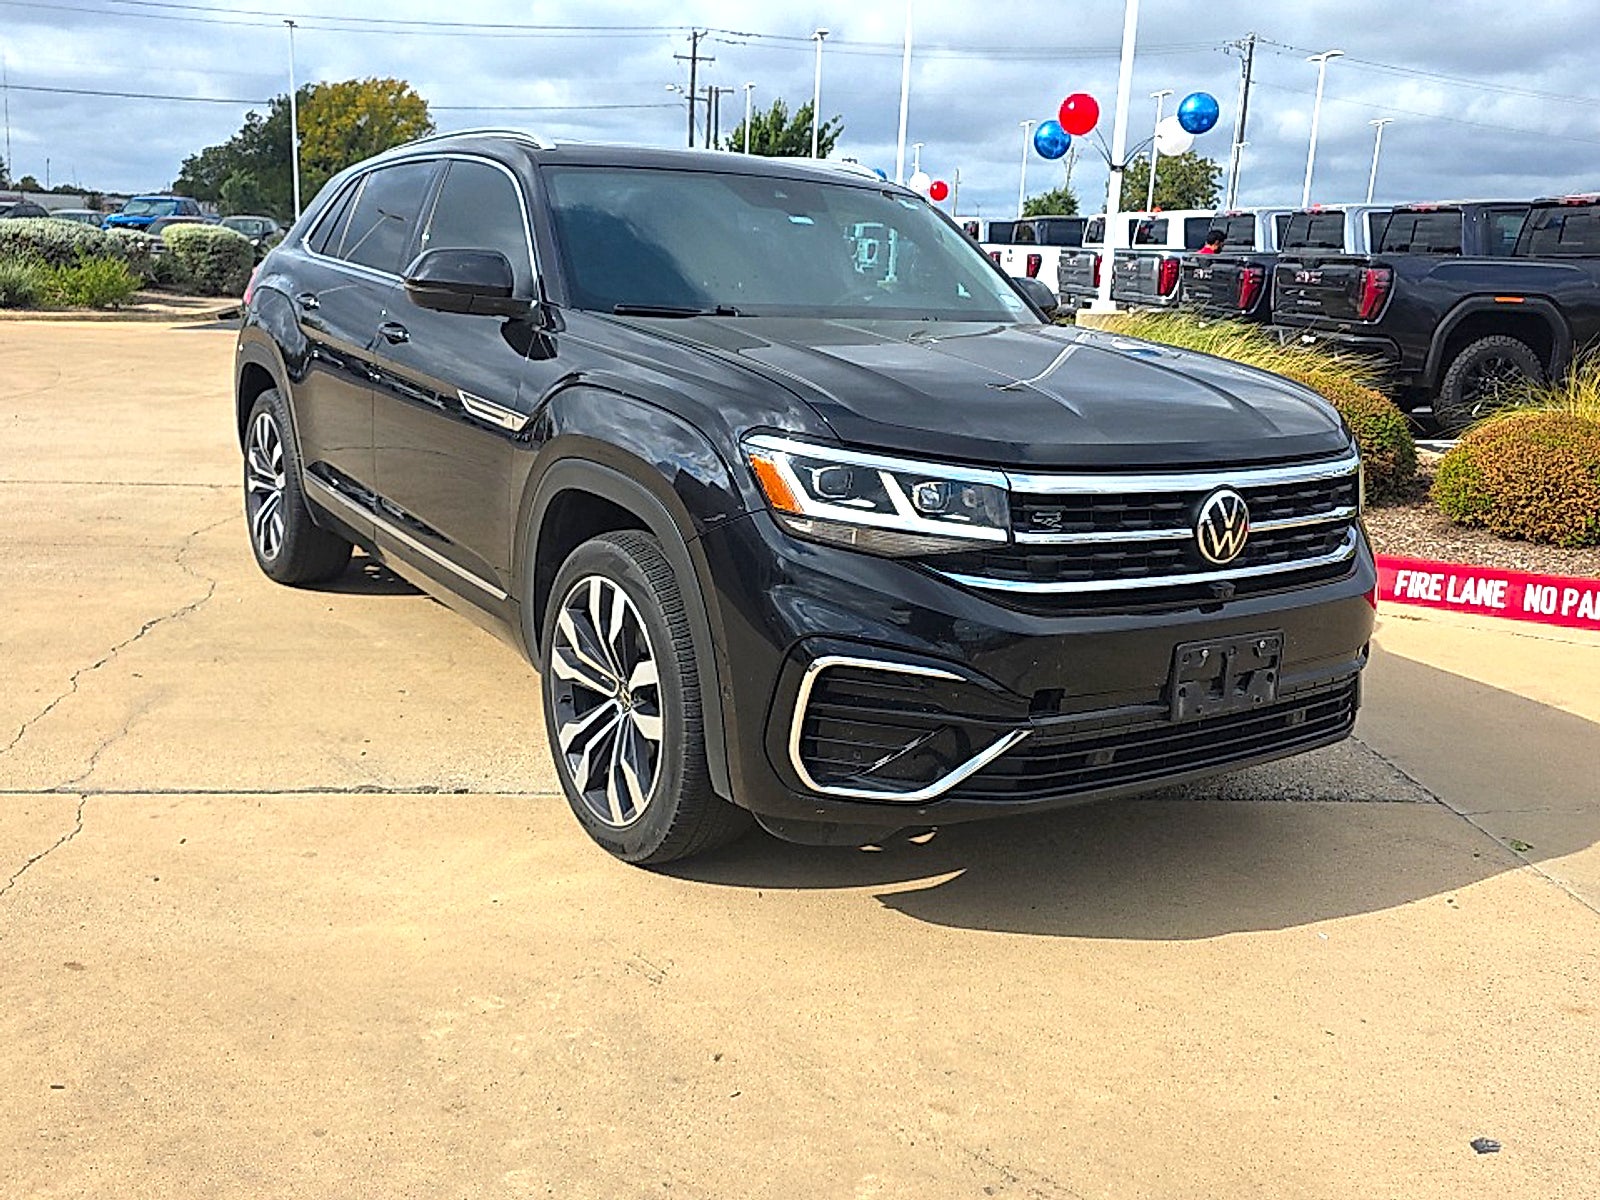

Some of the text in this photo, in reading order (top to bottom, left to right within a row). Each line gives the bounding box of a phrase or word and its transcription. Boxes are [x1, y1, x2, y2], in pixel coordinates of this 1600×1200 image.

[1394, 569, 1445, 602] FIRE
[1446, 574, 1509, 609] LANE
[1523, 583, 1558, 615] NO
